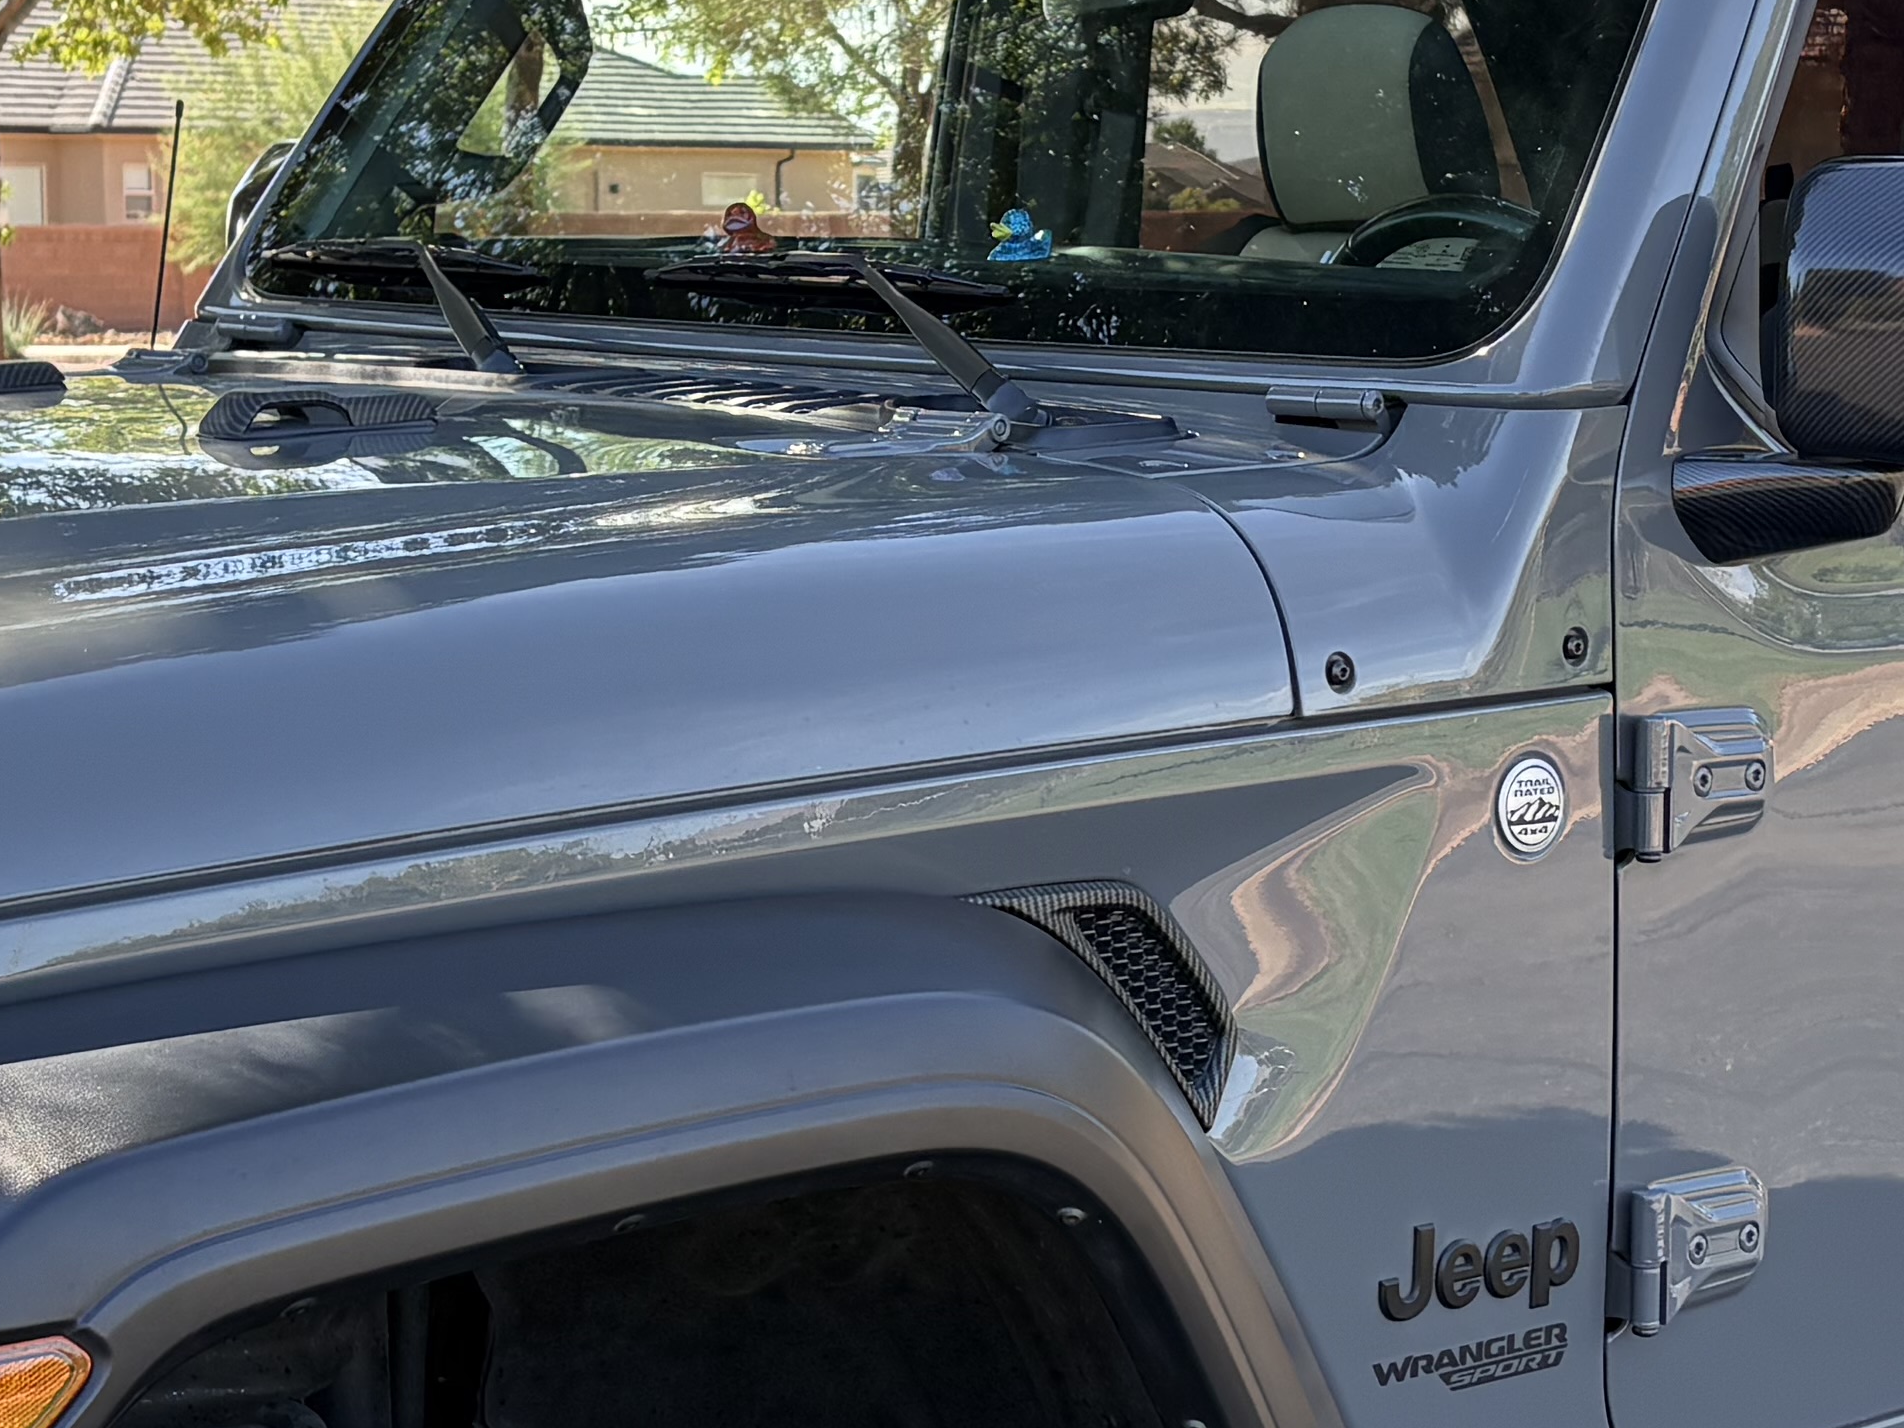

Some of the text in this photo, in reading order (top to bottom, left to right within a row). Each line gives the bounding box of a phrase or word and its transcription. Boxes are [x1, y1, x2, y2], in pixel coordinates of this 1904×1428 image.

[1514, 786, 1555, 797] RATED
[1516, 778, 1551, 788] TRAIL
[1517, 825, 1549, 836] 4x4
[1377, 1217, 1580, 1322] Jeep
[1372, 1322, 1568, 1387] WRANGLER
[1449, 1350, 1564, 1388] SPORT
